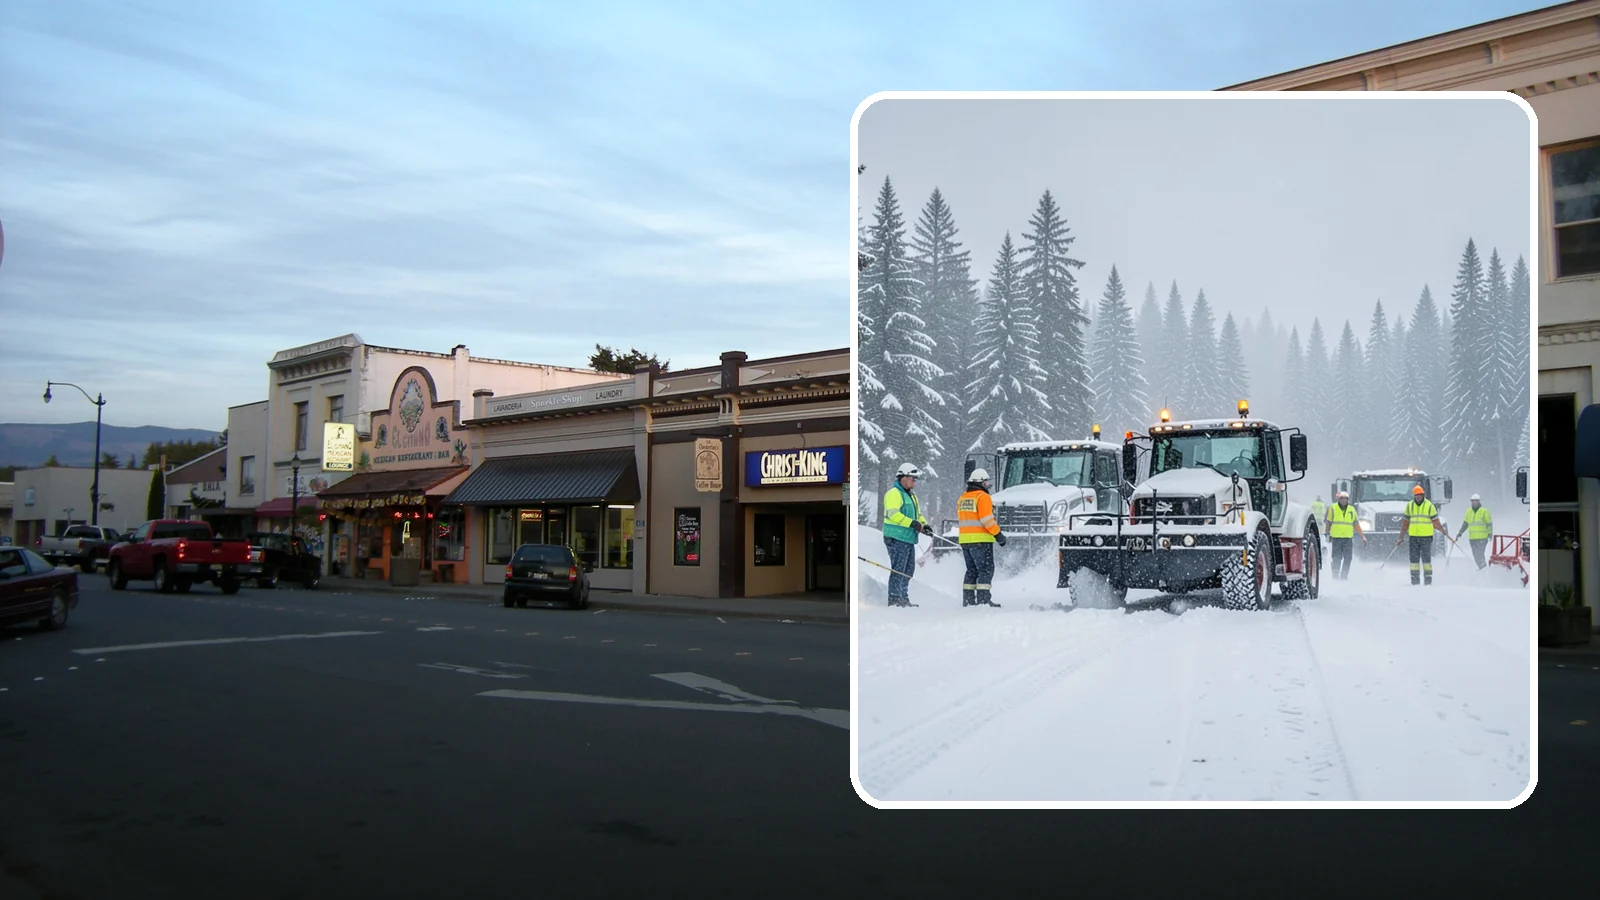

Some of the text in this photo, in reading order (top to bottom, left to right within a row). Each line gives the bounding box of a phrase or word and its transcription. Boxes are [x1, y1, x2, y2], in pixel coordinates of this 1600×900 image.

[493, 401, 522, 412] LAVANDERIA
[561, 394, 582, 404] Shop
[595, 389, 623, 400] LAUNDRY
[397, 451, 433, 462] RESTAURANT
[437, 450, 450, 459] BAR
[696, 480, 722, 488] Coffee House
